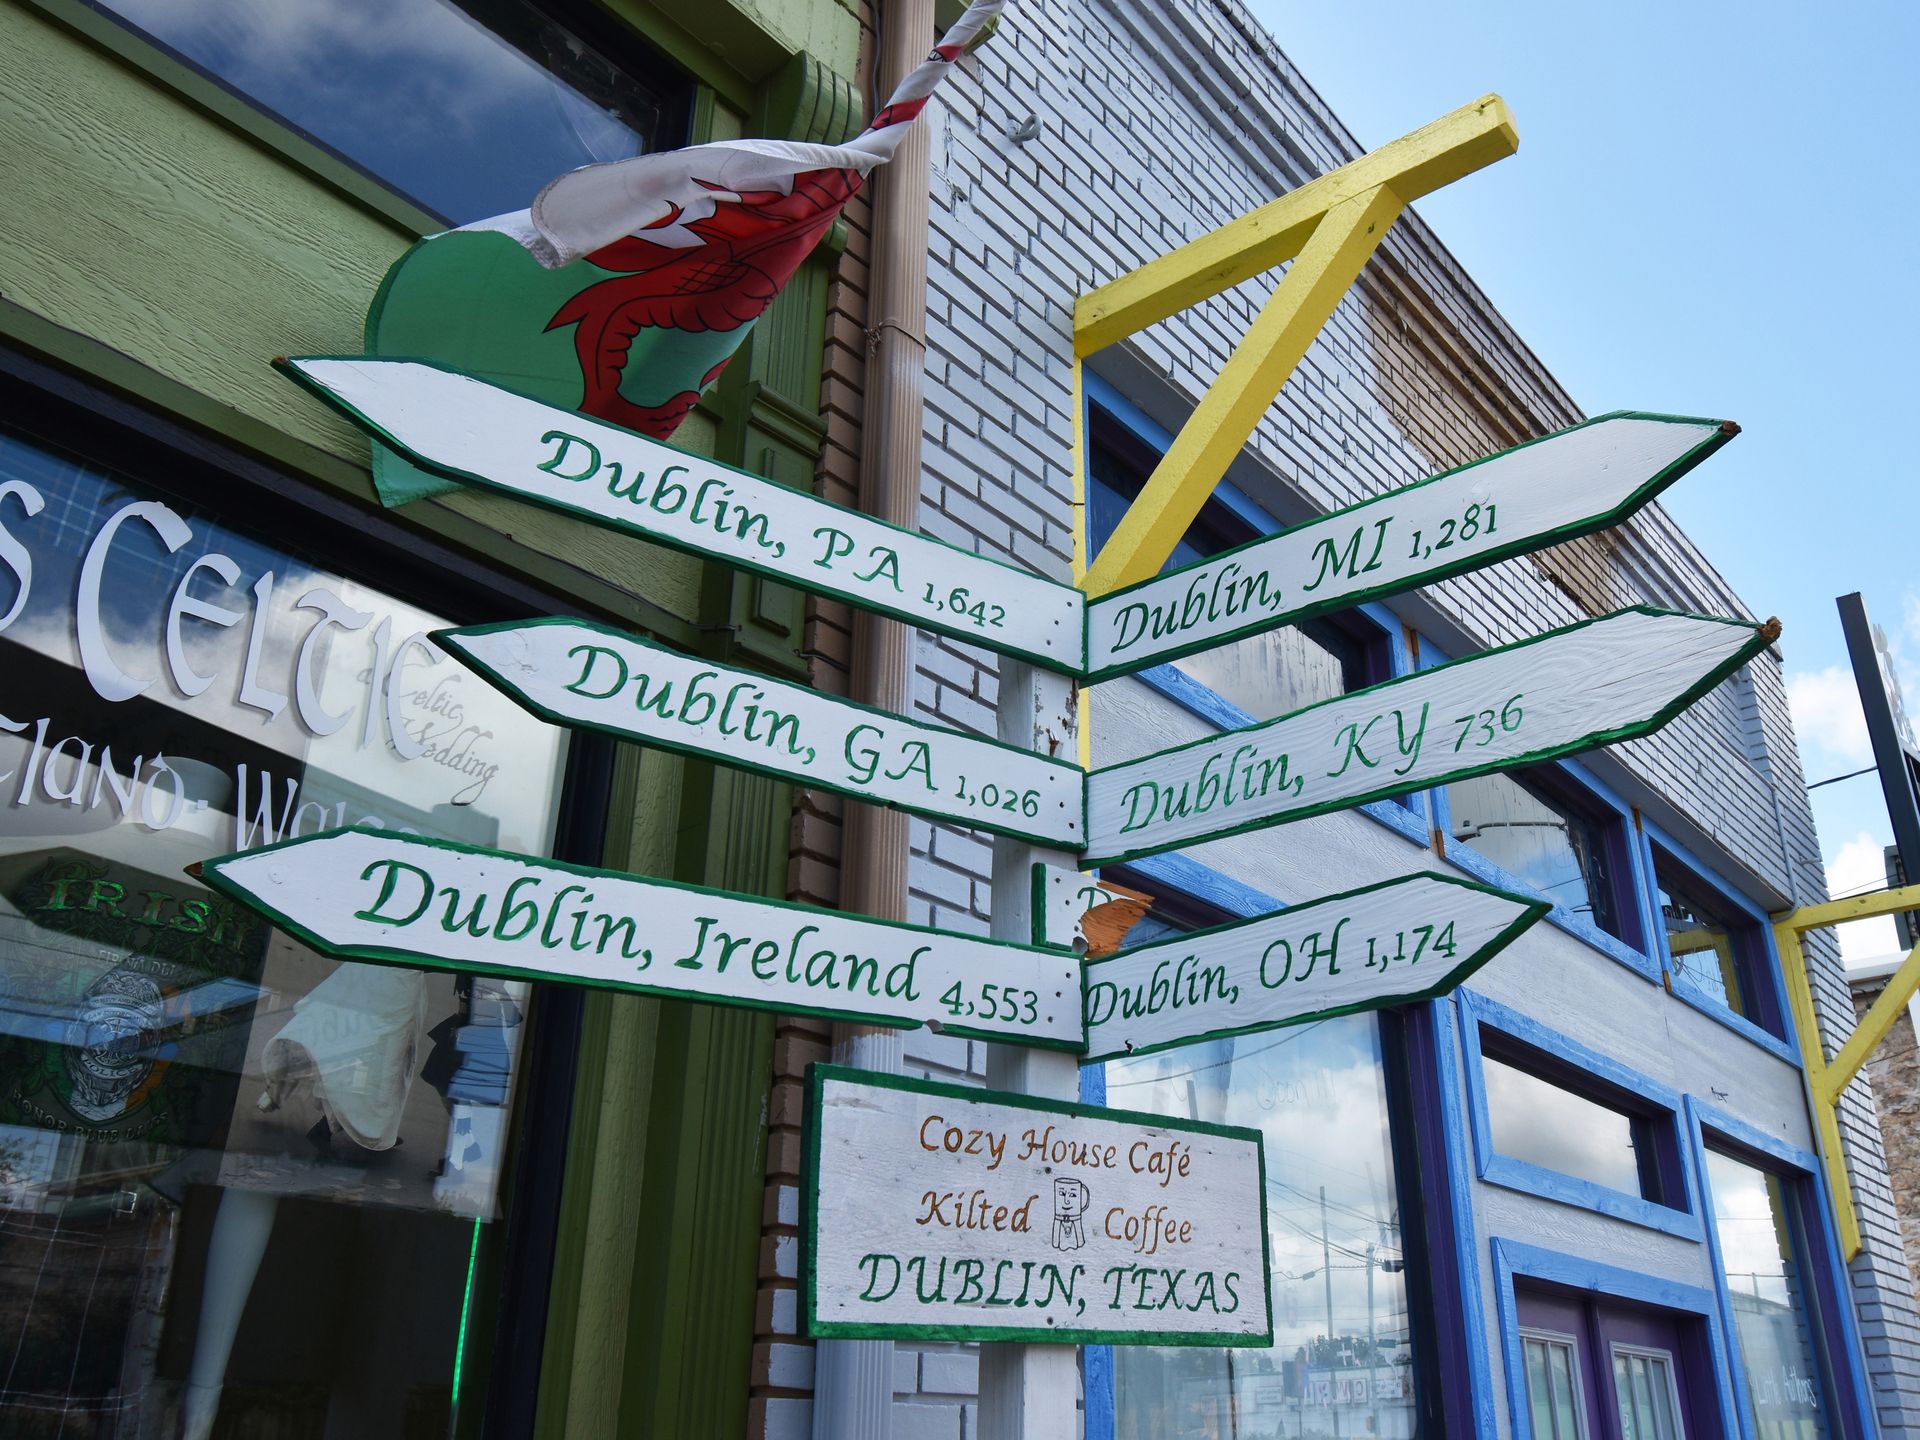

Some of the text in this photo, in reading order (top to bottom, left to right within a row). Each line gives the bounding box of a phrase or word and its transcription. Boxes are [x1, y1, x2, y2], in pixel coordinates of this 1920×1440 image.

[537, 430, 1007, 629] Dublin, PA 1,642
[1111, 503, 1498, 654] Dublin, MI 1,281
[382, 668, 465, 736] eltic
[563, 645, 1041, 818] Dublin, GA 1,026
[1119, 693, 1524, 834] Dublin, KY 736
[354, 859, 1040, 1026] Dublin, Ireland 4,553
[1087, 917, 1457, 1027] Dublin, OH 1,174
[83, 1058, 138, 1077] POLICE
[919, 1115, 1191, 1188] Cozy House Café
[916, 1189, 1192, 1255] Kilted Coffee
[858, 1253, 1240, 1317] DUBLIN, TEXAS
